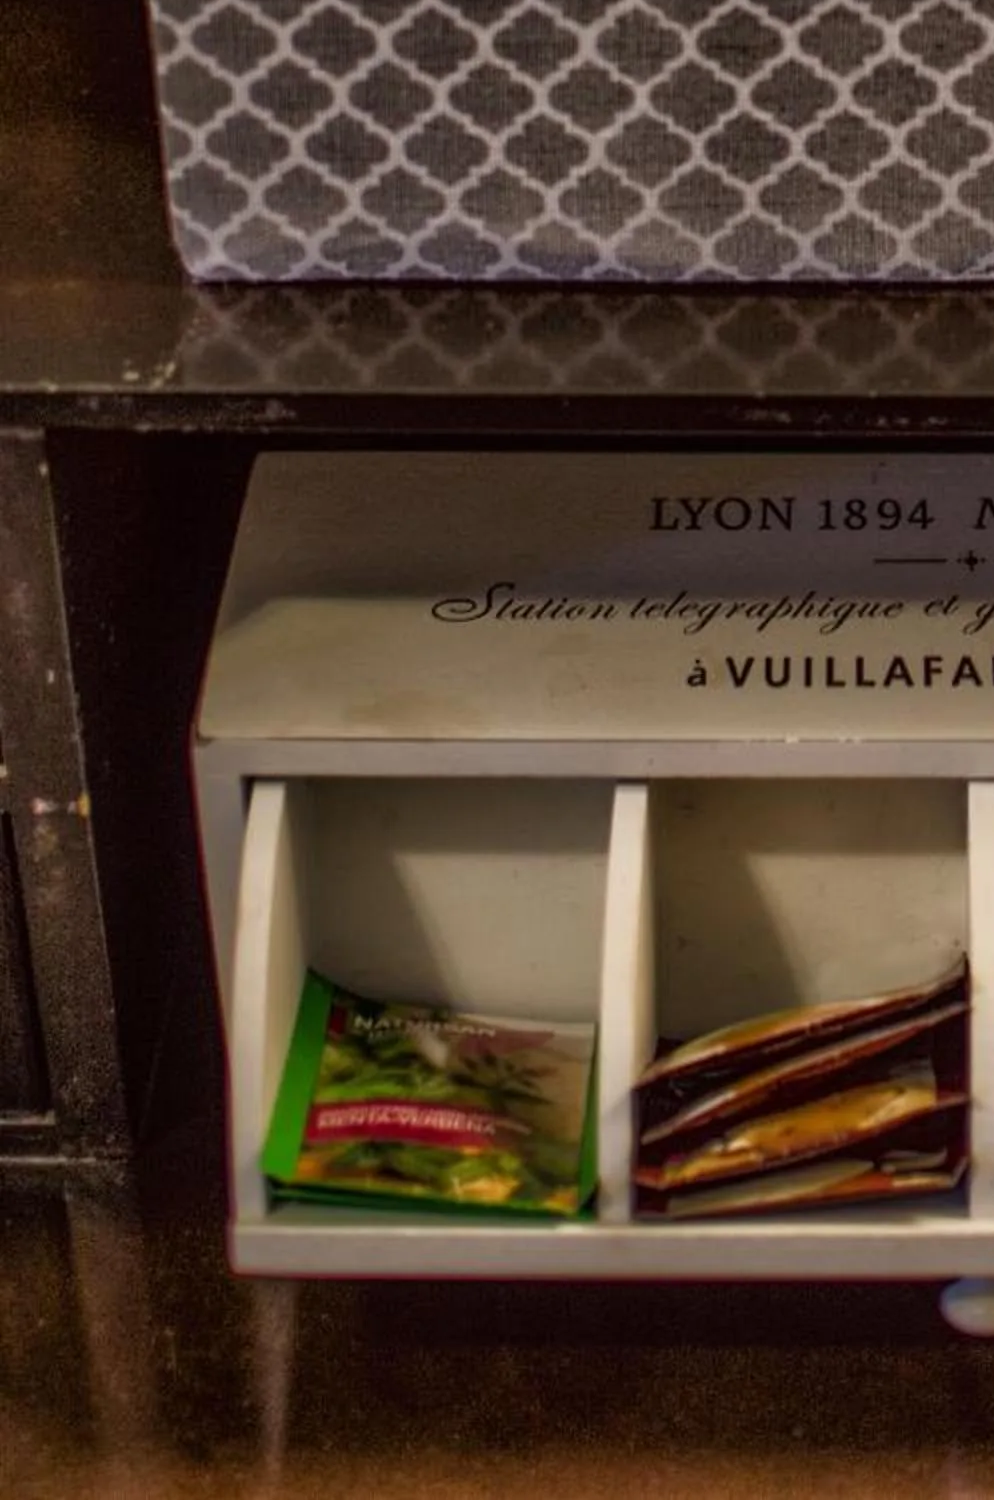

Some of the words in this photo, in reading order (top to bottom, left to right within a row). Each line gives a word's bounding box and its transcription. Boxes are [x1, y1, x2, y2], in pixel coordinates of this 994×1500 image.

[649, 496, 796, 532] LYON
[818, 497, 935, 531] 1894
[431, 582, 616, 623] Station
[629, 590, 904, 635] telegraphique
[923, 594, 958, 617] et
[686, 658, 707, 688] à
